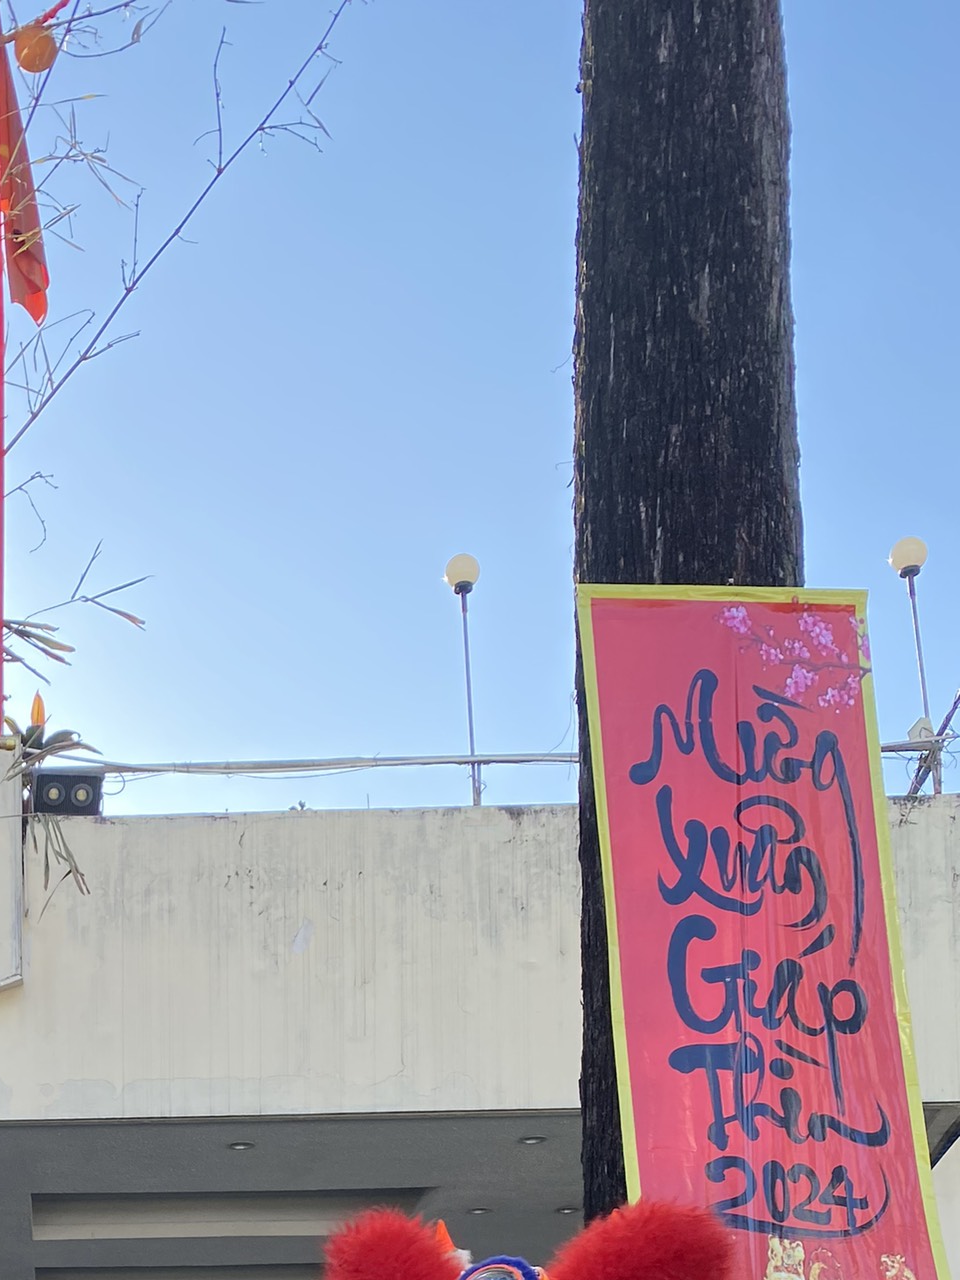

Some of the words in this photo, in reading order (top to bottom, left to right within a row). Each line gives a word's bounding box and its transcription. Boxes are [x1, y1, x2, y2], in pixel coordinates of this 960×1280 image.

[629, 669, 864, 974] Mừng
[656, 784, 829, 931] Xuân
[667, 914, 868, 1116] Giáp
[669, 1031, 890, 1150] Thìn
[705, 1156, 890, 1239] 2024
